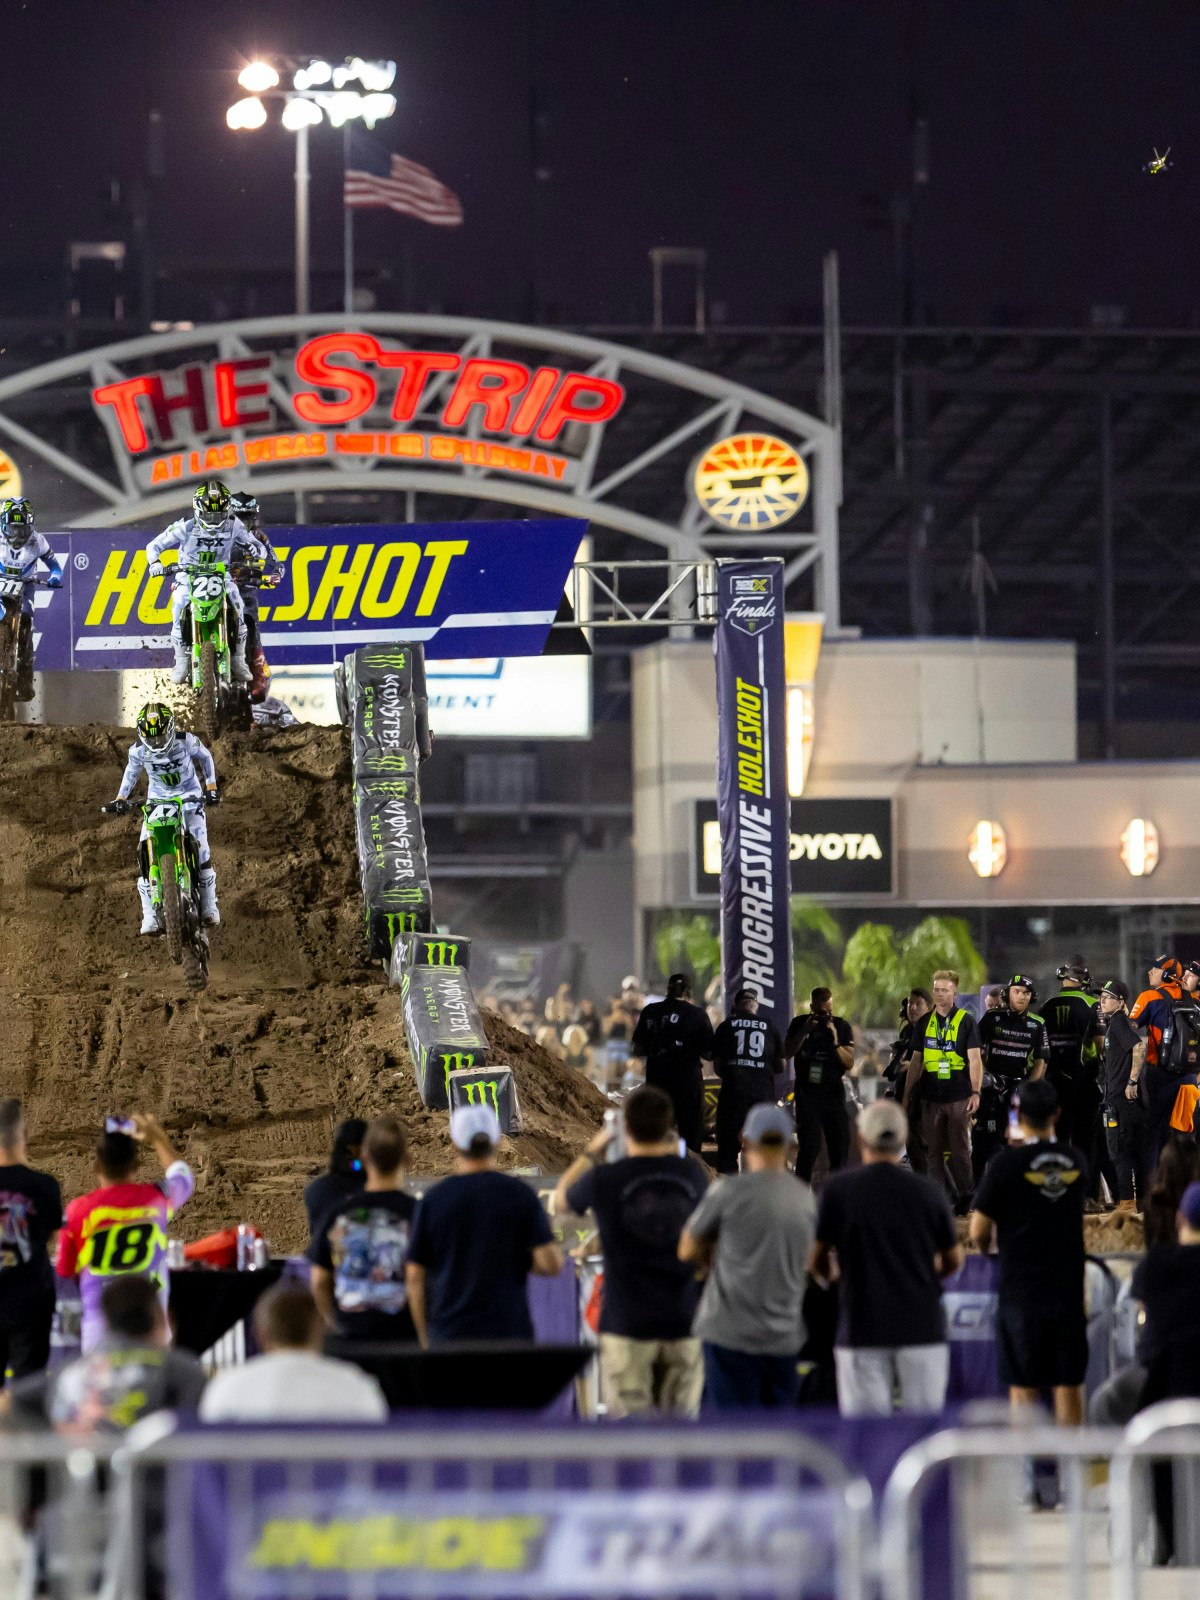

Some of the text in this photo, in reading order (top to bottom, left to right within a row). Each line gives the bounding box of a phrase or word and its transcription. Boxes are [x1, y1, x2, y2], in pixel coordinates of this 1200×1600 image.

[94, 332, 625, 453] THE STRIP
[192, 577, 223, 598] 26
[725, 596, 776, 620] Finals
[379, 673, 404, 748] MONSTER
[736, 677, 763, 797] HOLESHOT
[148, 803, 180, 822] 47
[384, 800, 415, 881] MONSTER
[789, 832, 883, 861] OYOTA
[739, 800, 774, 1009] PROGRESSIVE
[438, 978, 471, 1032] MONSTER
[731, 1019, 767, 1030] VIDEO
[734, 1029, 765, 1058] 19
[90, 1223, 154, 1269] 18
